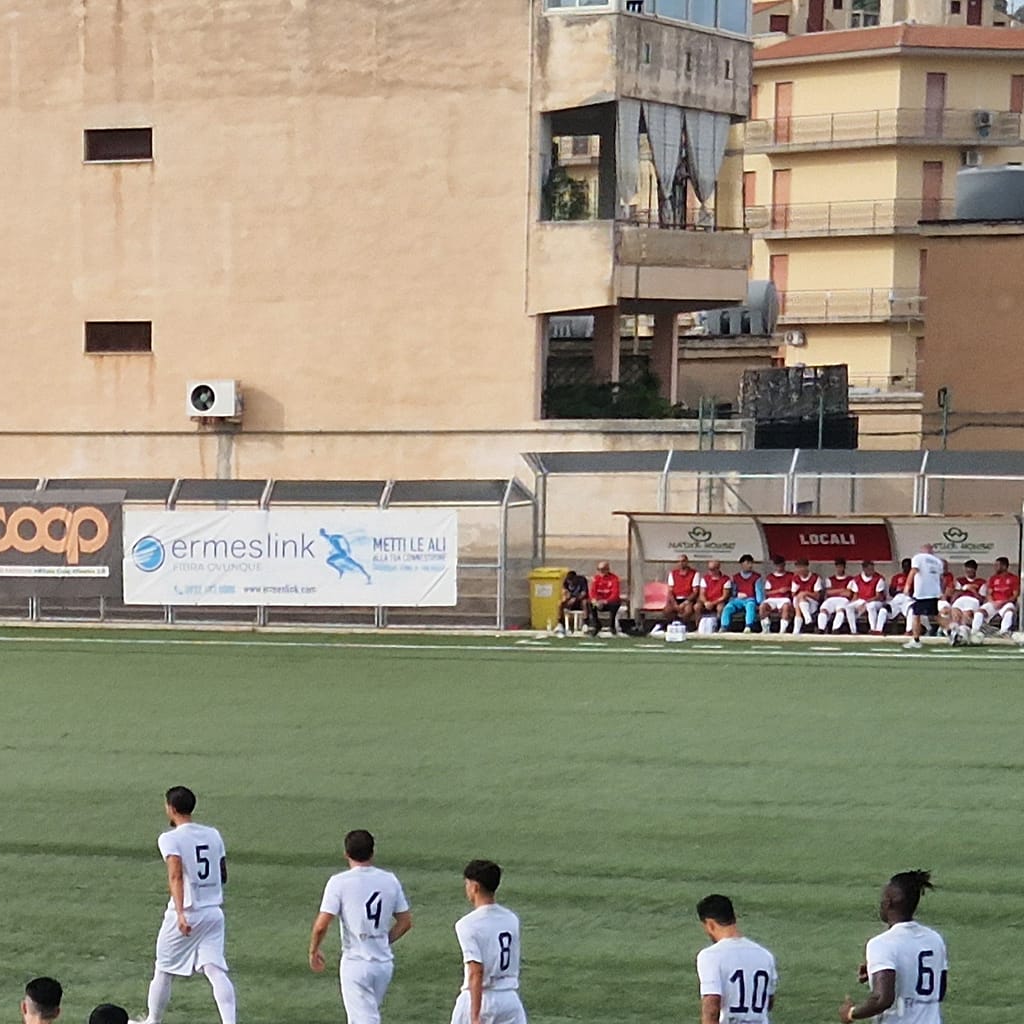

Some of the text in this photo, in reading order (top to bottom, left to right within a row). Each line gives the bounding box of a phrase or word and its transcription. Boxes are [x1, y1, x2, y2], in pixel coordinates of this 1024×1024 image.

[171, 532, 316, 559] ermeslink
[372, 536, 447, 553] METTI LE ALI
[798, 532, 856, 546] LOCALI
[195, 844, 210, 881] 5
[365, 890, 383, 930] 4
[498, 931, 513, 972] 8
[729, 969, 770, 1014] 10
[915, 950, 936, 996] 6
